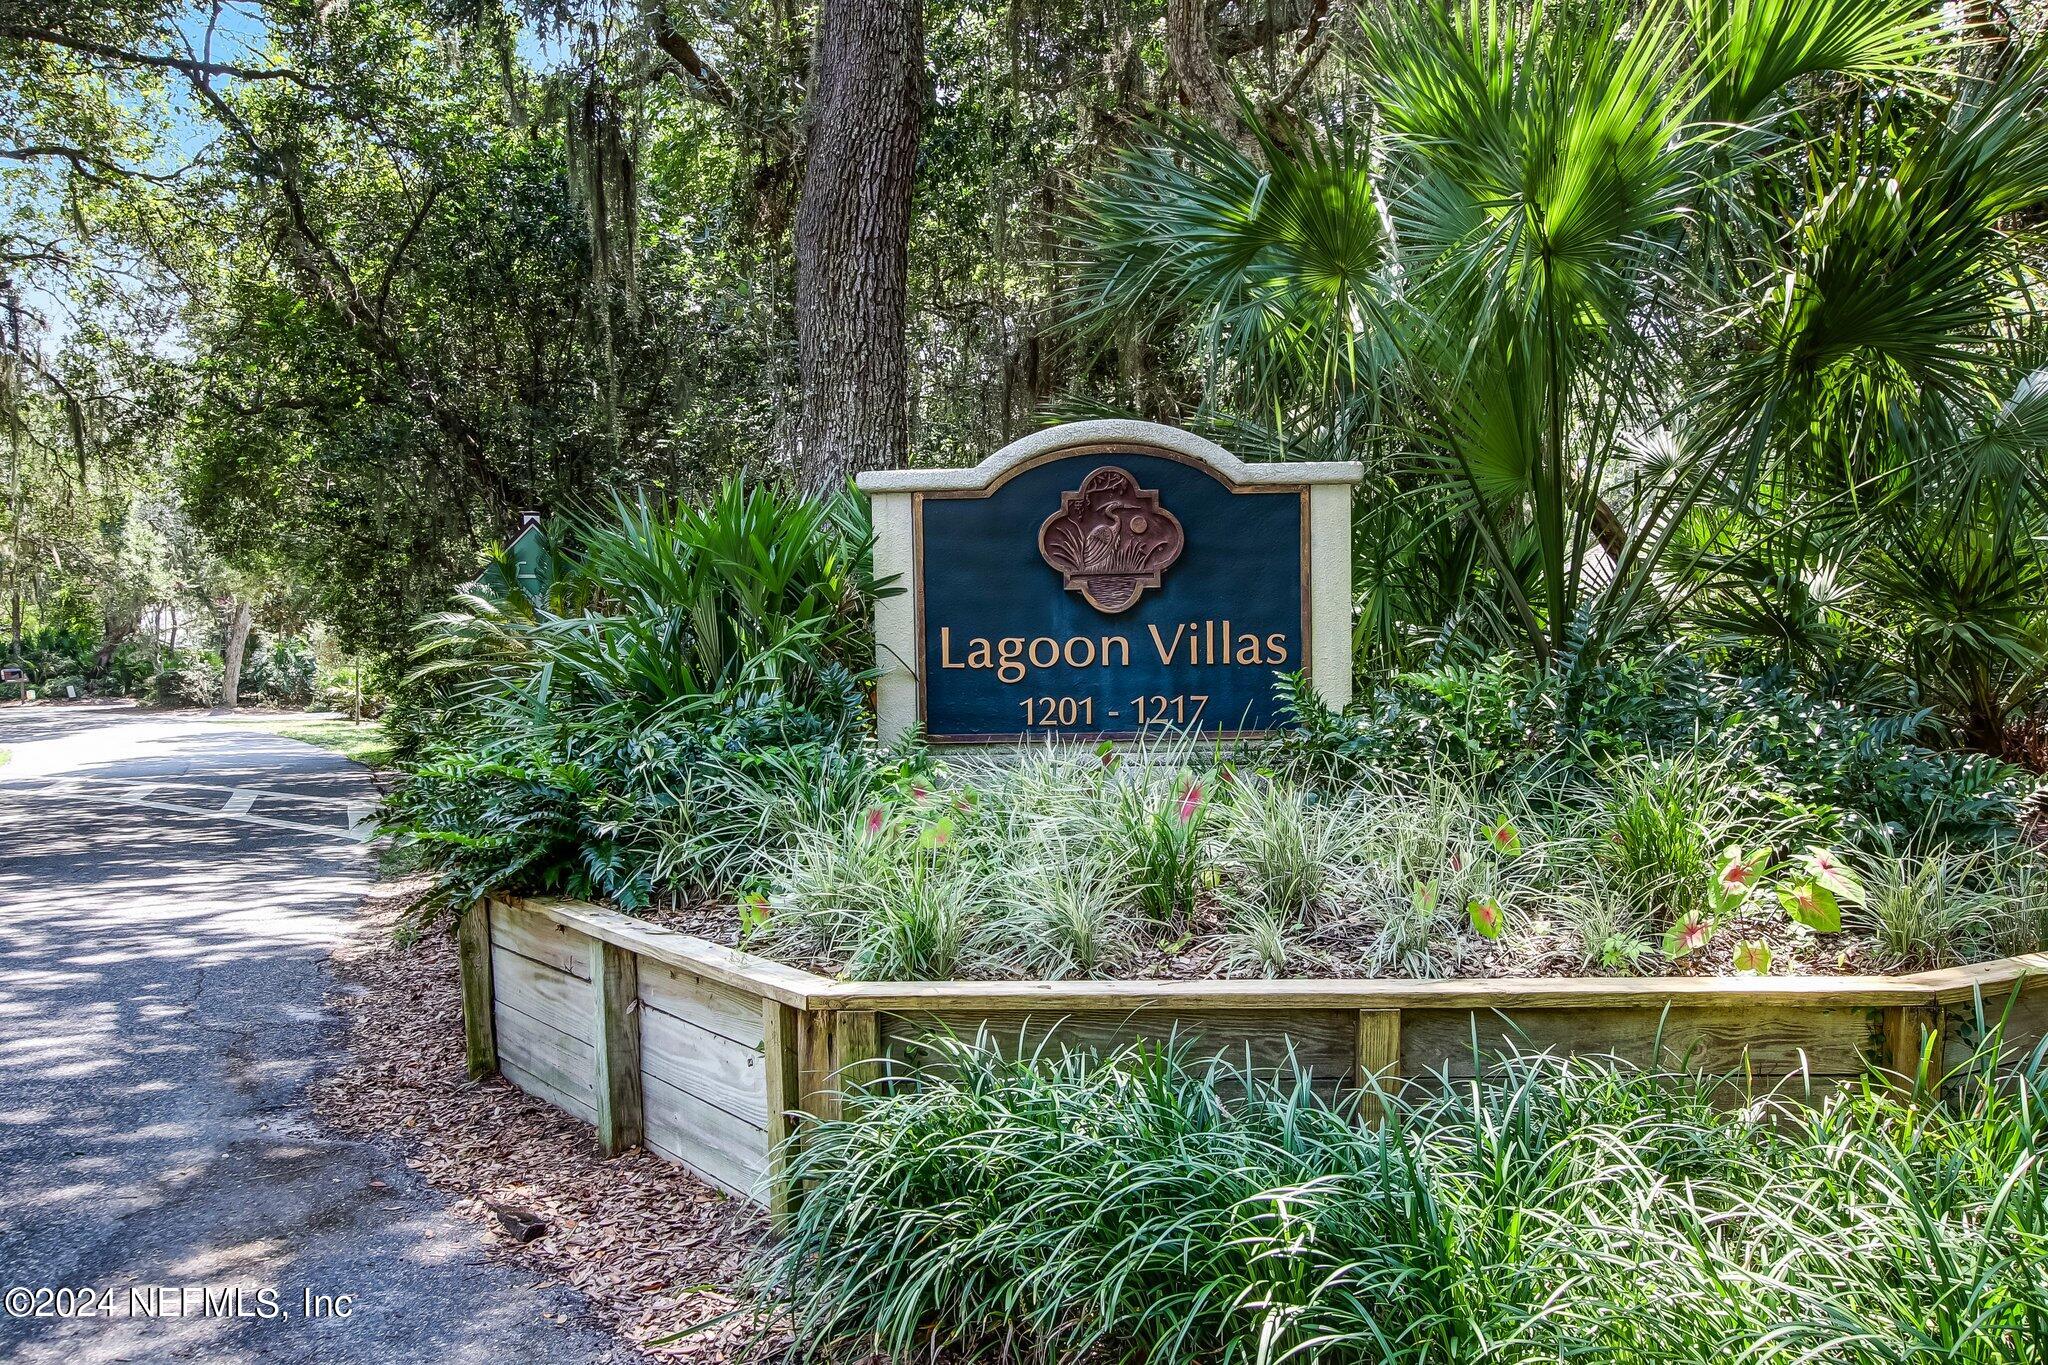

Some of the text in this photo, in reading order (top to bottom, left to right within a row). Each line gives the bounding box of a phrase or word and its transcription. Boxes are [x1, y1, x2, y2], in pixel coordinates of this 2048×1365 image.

[940, 620, 1288, 684] Lagoon Villas
[1019, 696, 1093, 726] 1201
[1130, 694, 1209, 725] 1217
